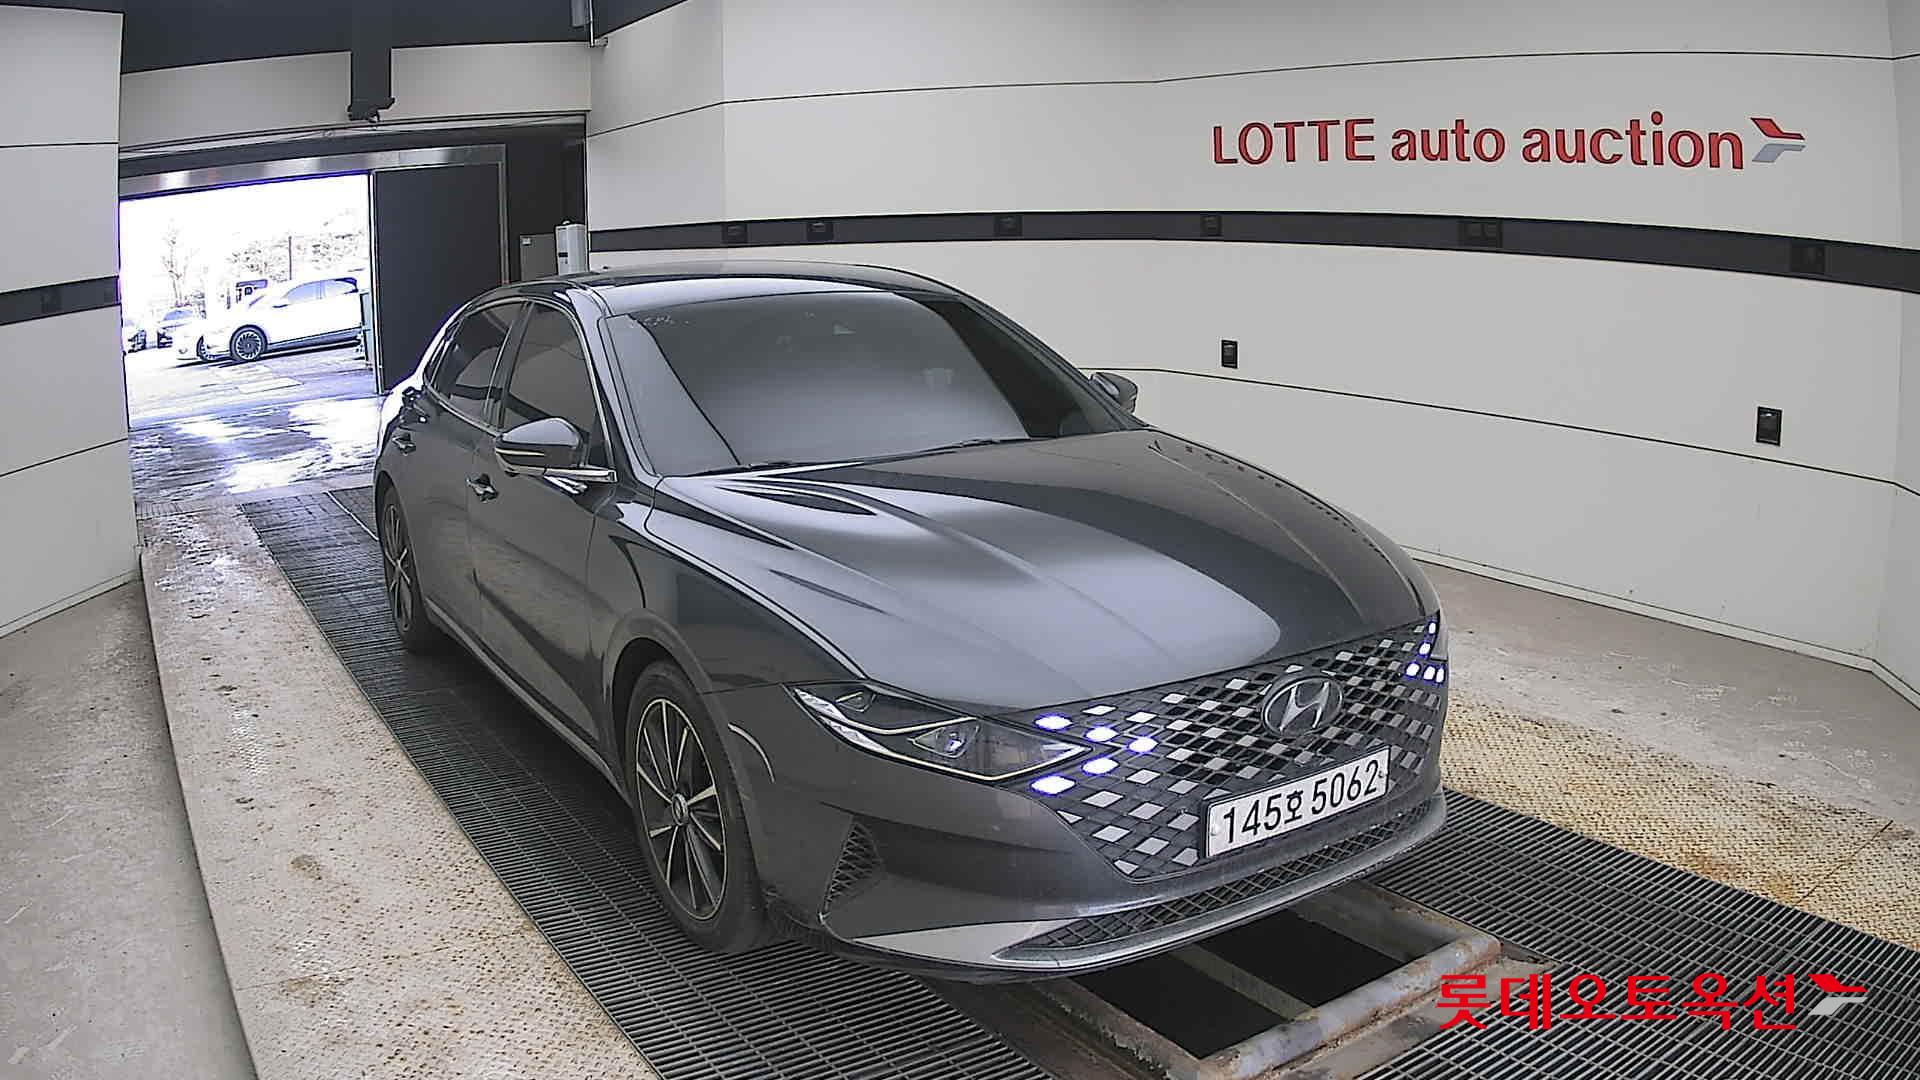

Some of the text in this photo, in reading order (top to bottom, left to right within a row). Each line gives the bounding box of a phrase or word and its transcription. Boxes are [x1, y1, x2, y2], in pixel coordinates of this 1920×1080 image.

[1213, 110, 1744, 170] LOTTE auto auction
[1223, 759, 1379, 844] 145호 5062
